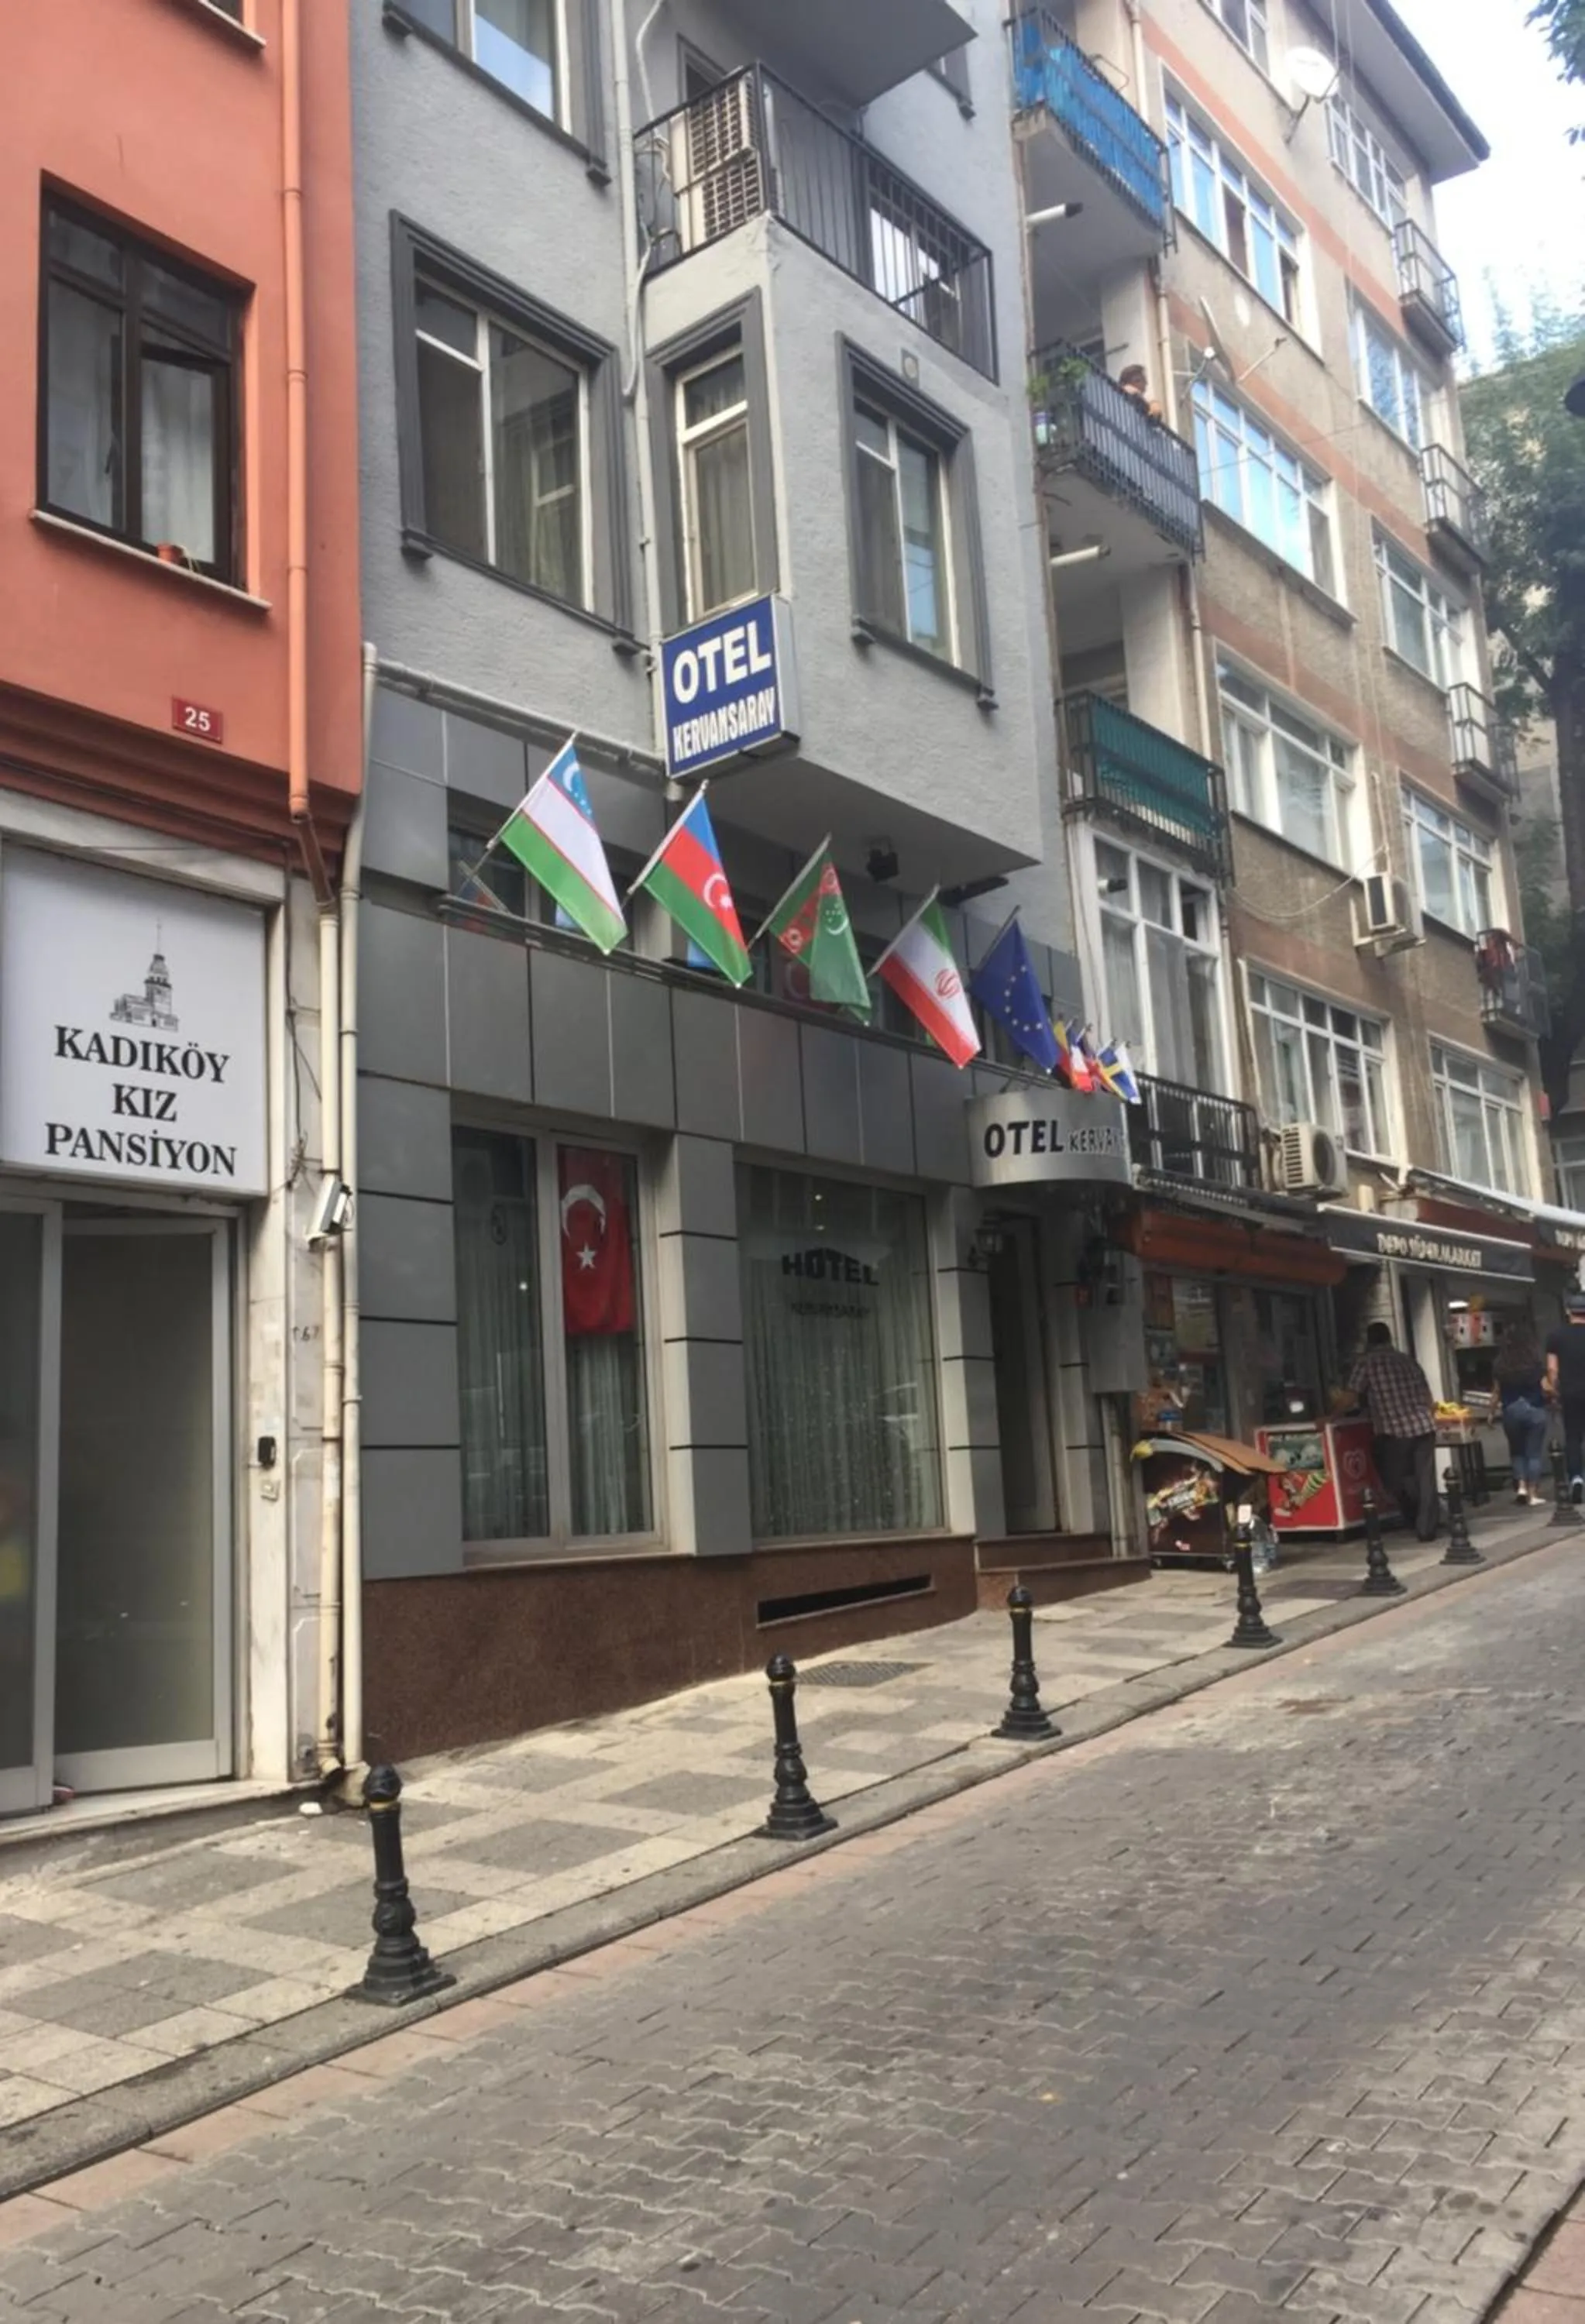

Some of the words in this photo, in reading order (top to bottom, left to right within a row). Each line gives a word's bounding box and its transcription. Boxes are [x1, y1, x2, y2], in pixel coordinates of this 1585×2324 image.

[672, 621, 772, 704] OTEL
[185, 706, 211, 732] 25
[672, 686, 775, 763] KERVANSARAY
[54, 1025, 230, 1084] KADIKÖY
[112, 1083, 177, 1122] KIZ
[45, 1122, 237, 1177] PANSİYON
[984, 1119, 1064, 1158] OTEL
[781, 1247, 880, 1286] HOTEL
